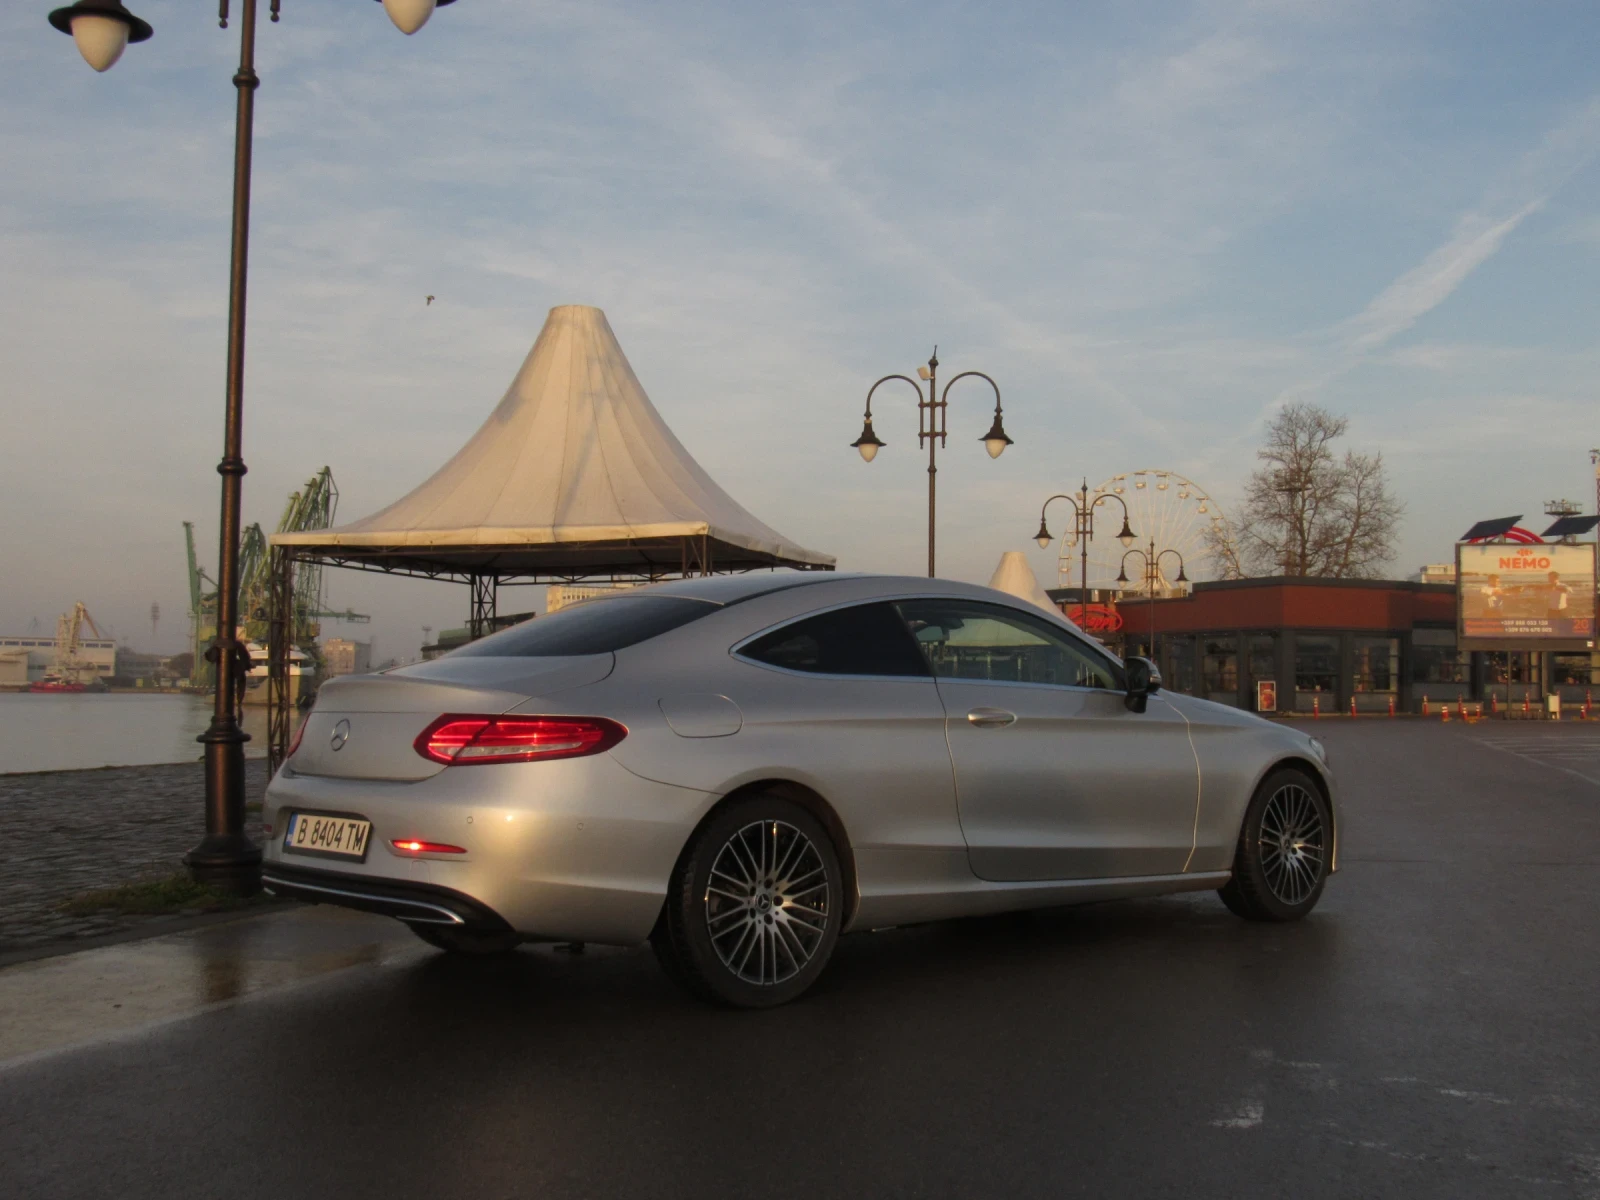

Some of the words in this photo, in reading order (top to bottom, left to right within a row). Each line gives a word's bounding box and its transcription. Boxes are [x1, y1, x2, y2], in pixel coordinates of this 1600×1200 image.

[1499, 557, 1551, 569] NEMO
[297, 818, 308, 844] B
[310, 819, 345, 849] 8404
[346, 823, 367, 851] TM
